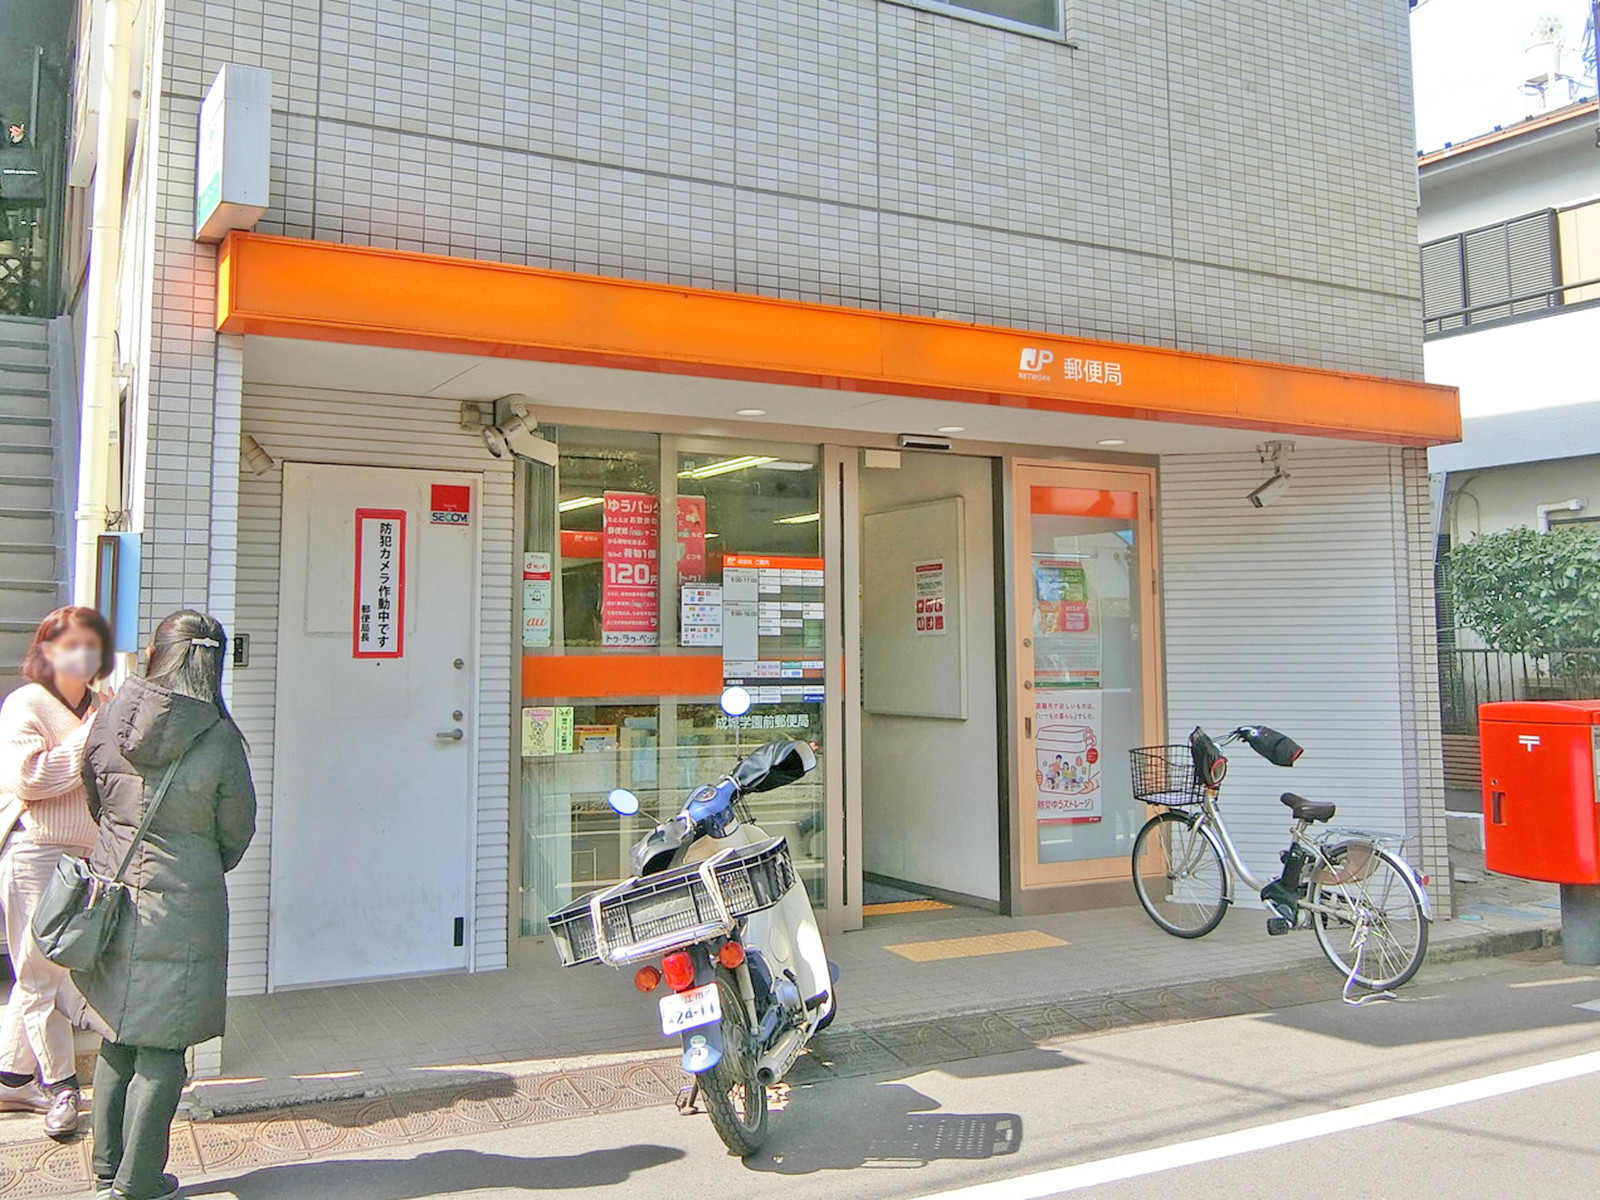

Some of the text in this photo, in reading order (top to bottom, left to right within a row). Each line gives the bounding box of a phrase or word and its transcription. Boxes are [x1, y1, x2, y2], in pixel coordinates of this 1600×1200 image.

[1020, 348, 1122, 386] JP 郵便局
[1018, 372, 1051, 382] NETWORK
[432, 512, 467, 522] SECOM
[378, 522, 392, 648] 防犯カメラ作動中です
[360, 604, 371, 642] 郵便局長
[526, 618, 547, 627] au
[715, 714, 810, 730] 成城学園前郵便局
